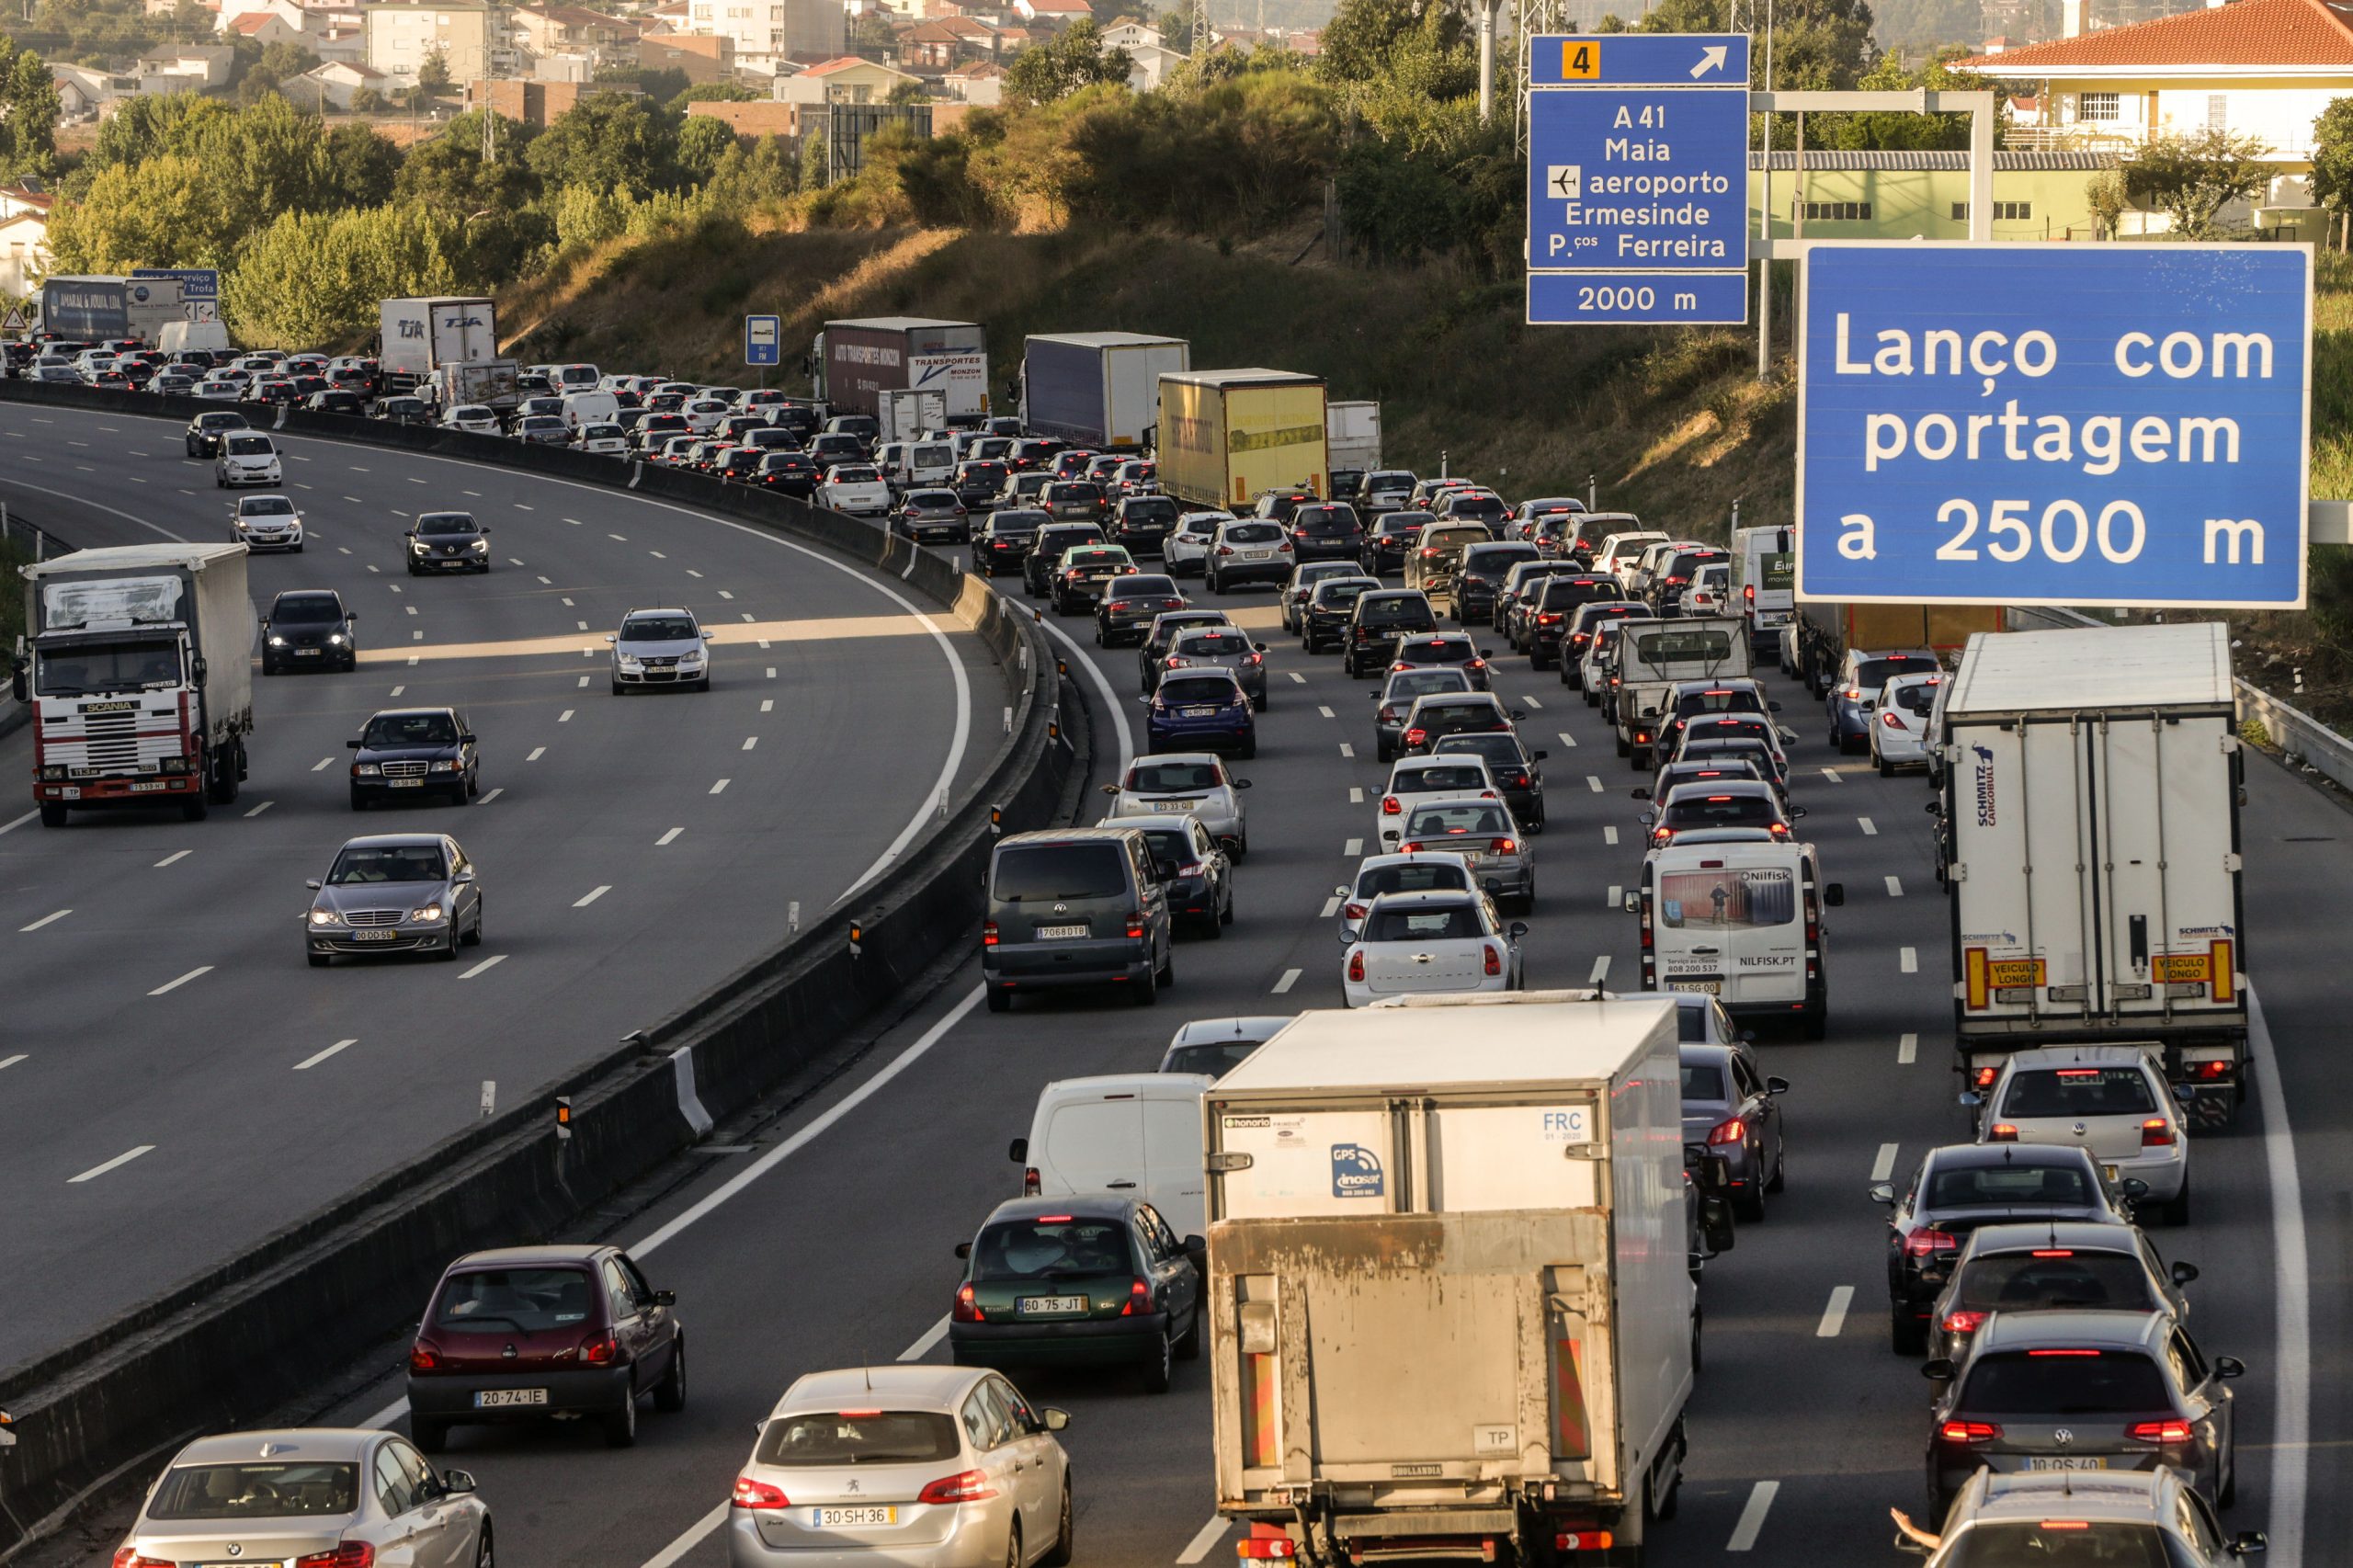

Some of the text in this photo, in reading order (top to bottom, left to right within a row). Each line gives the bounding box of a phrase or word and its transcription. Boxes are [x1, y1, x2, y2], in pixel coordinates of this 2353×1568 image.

[1573, 47, 1590, 74] 4
[1613, 106, 1665, 129] A 41
[1605, 138, 1671, 162] Maia
[1589, 170, 1729, 198] aeroporto
[1565, 202, 1710, 225] Ermesinde
[1618, 233, 1726, 257] Ferreira
[189, 284, 214, 293] Trofa
[61, 293, 84, 309] AMARAL
[1578, 287, 1697, 311] 2000 m
[398, 319, 425, 338] TJA
[444, 317, 483, 328] TJA
[835, 344, 900, 368] AUTO TRANSPORTES MONZON
[915, 357, 981, 366] TRANSPORTES
[1836, 312, 2273, 396] Lanço com
[1866, 400, 2240, 475] portagem
[1837, 498, 2265, 564] a 2500 m
[86, 701, 132, 712] SCANIA
[1976, 765, 1987, 826] SCHMITZ
[1986, 765, 1995, 826] CARGOBULL
[1751, 871, 1790, 881] Nilfisk
[2179, 926, 2219, 935] SCHMITZ
[1740, 957, 1796, 966] NILFISK.PT
[1995, 963, 2039, 972] VEICULO
[2159, 959, 2204, 968] VEICULO
[1544, 1112, 1581, 1131] FRC
[1334, 1149, 1356, 1161] GPS
[1488, 1431, 1509, 1444] TP
[1392, 1465, 1442, 1477] DHOLLANDIA
